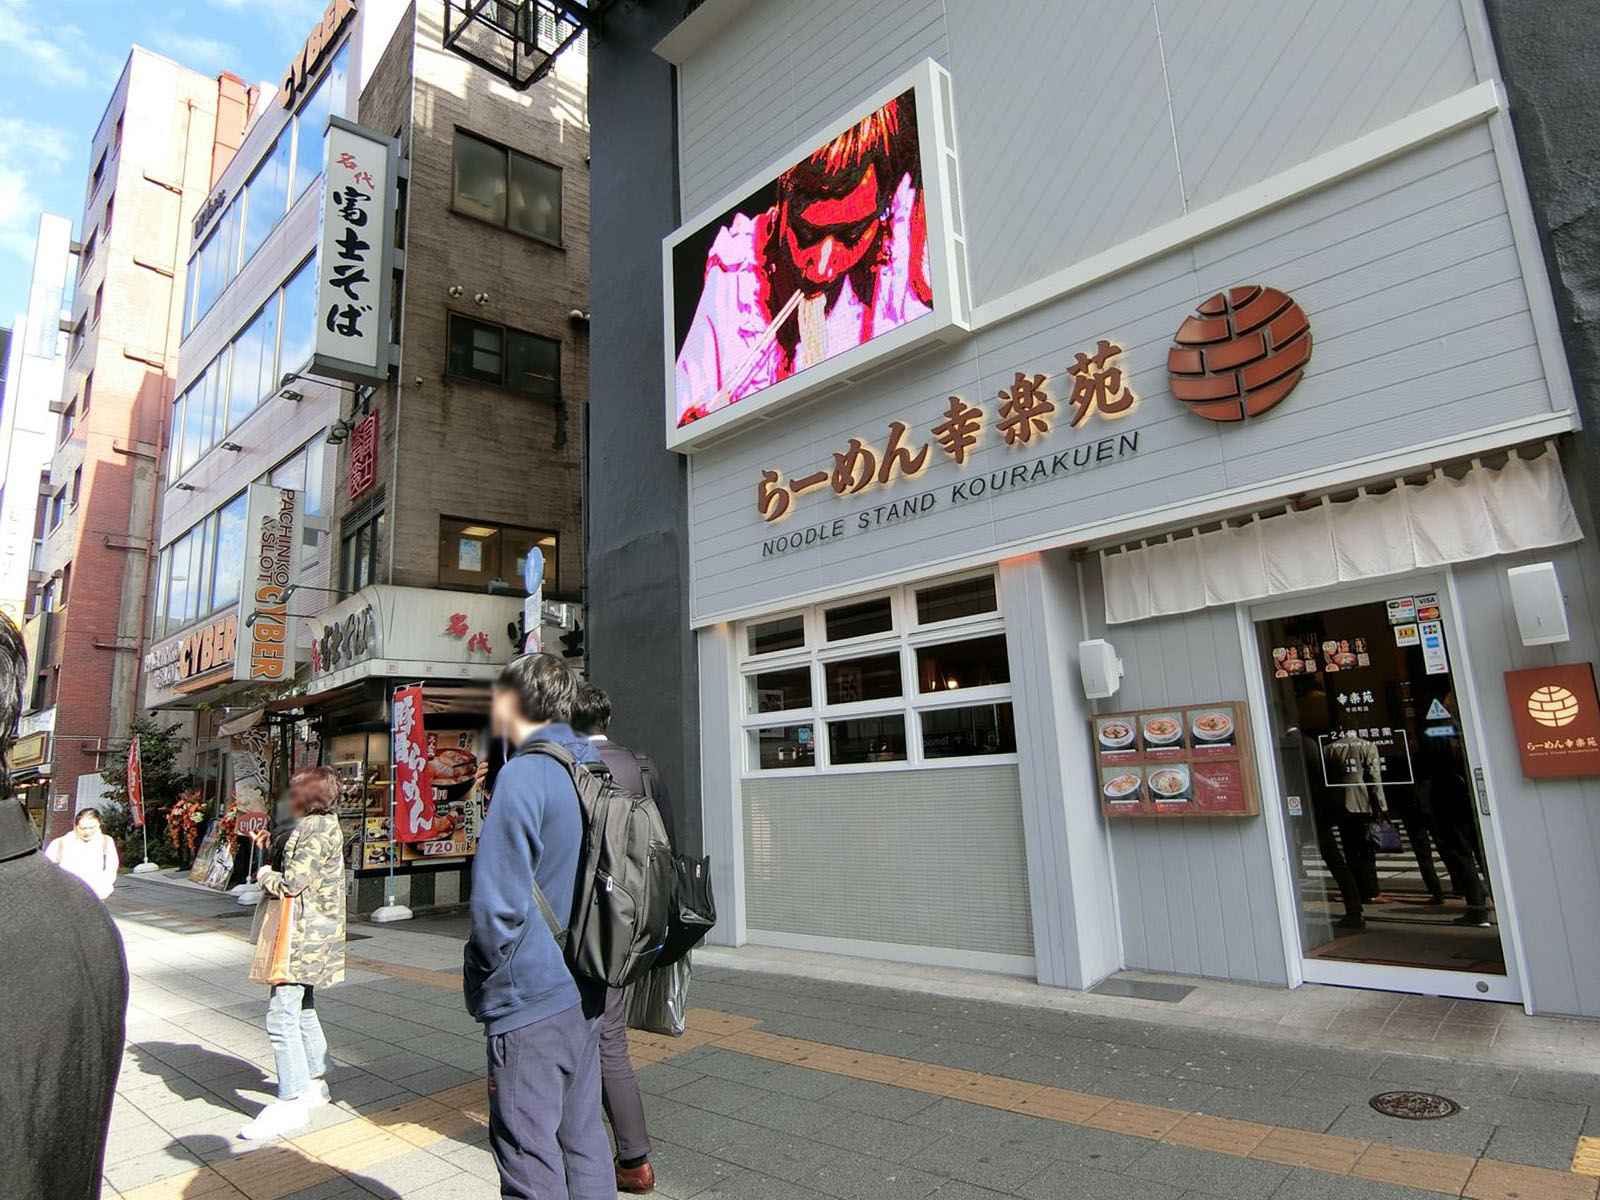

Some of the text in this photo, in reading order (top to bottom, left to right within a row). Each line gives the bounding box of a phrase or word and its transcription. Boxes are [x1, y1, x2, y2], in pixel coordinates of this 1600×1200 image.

[280, 0, 358, 111] CYBER
[336, 153, 376, 191] 名代
[326, 186, 373, 338] 富士そば
[757, 340, 1134, 522] らーめん幸楽苑
[275, 488, 296, 587] PACHINKO
[762, 431, 1139, 556] NOODLE STAND KOURAKUEN
[180, 614, 239, 679] CYBER
[250, 585, 288, 679] CYBER
[445, 612, 492, 654] 名代
